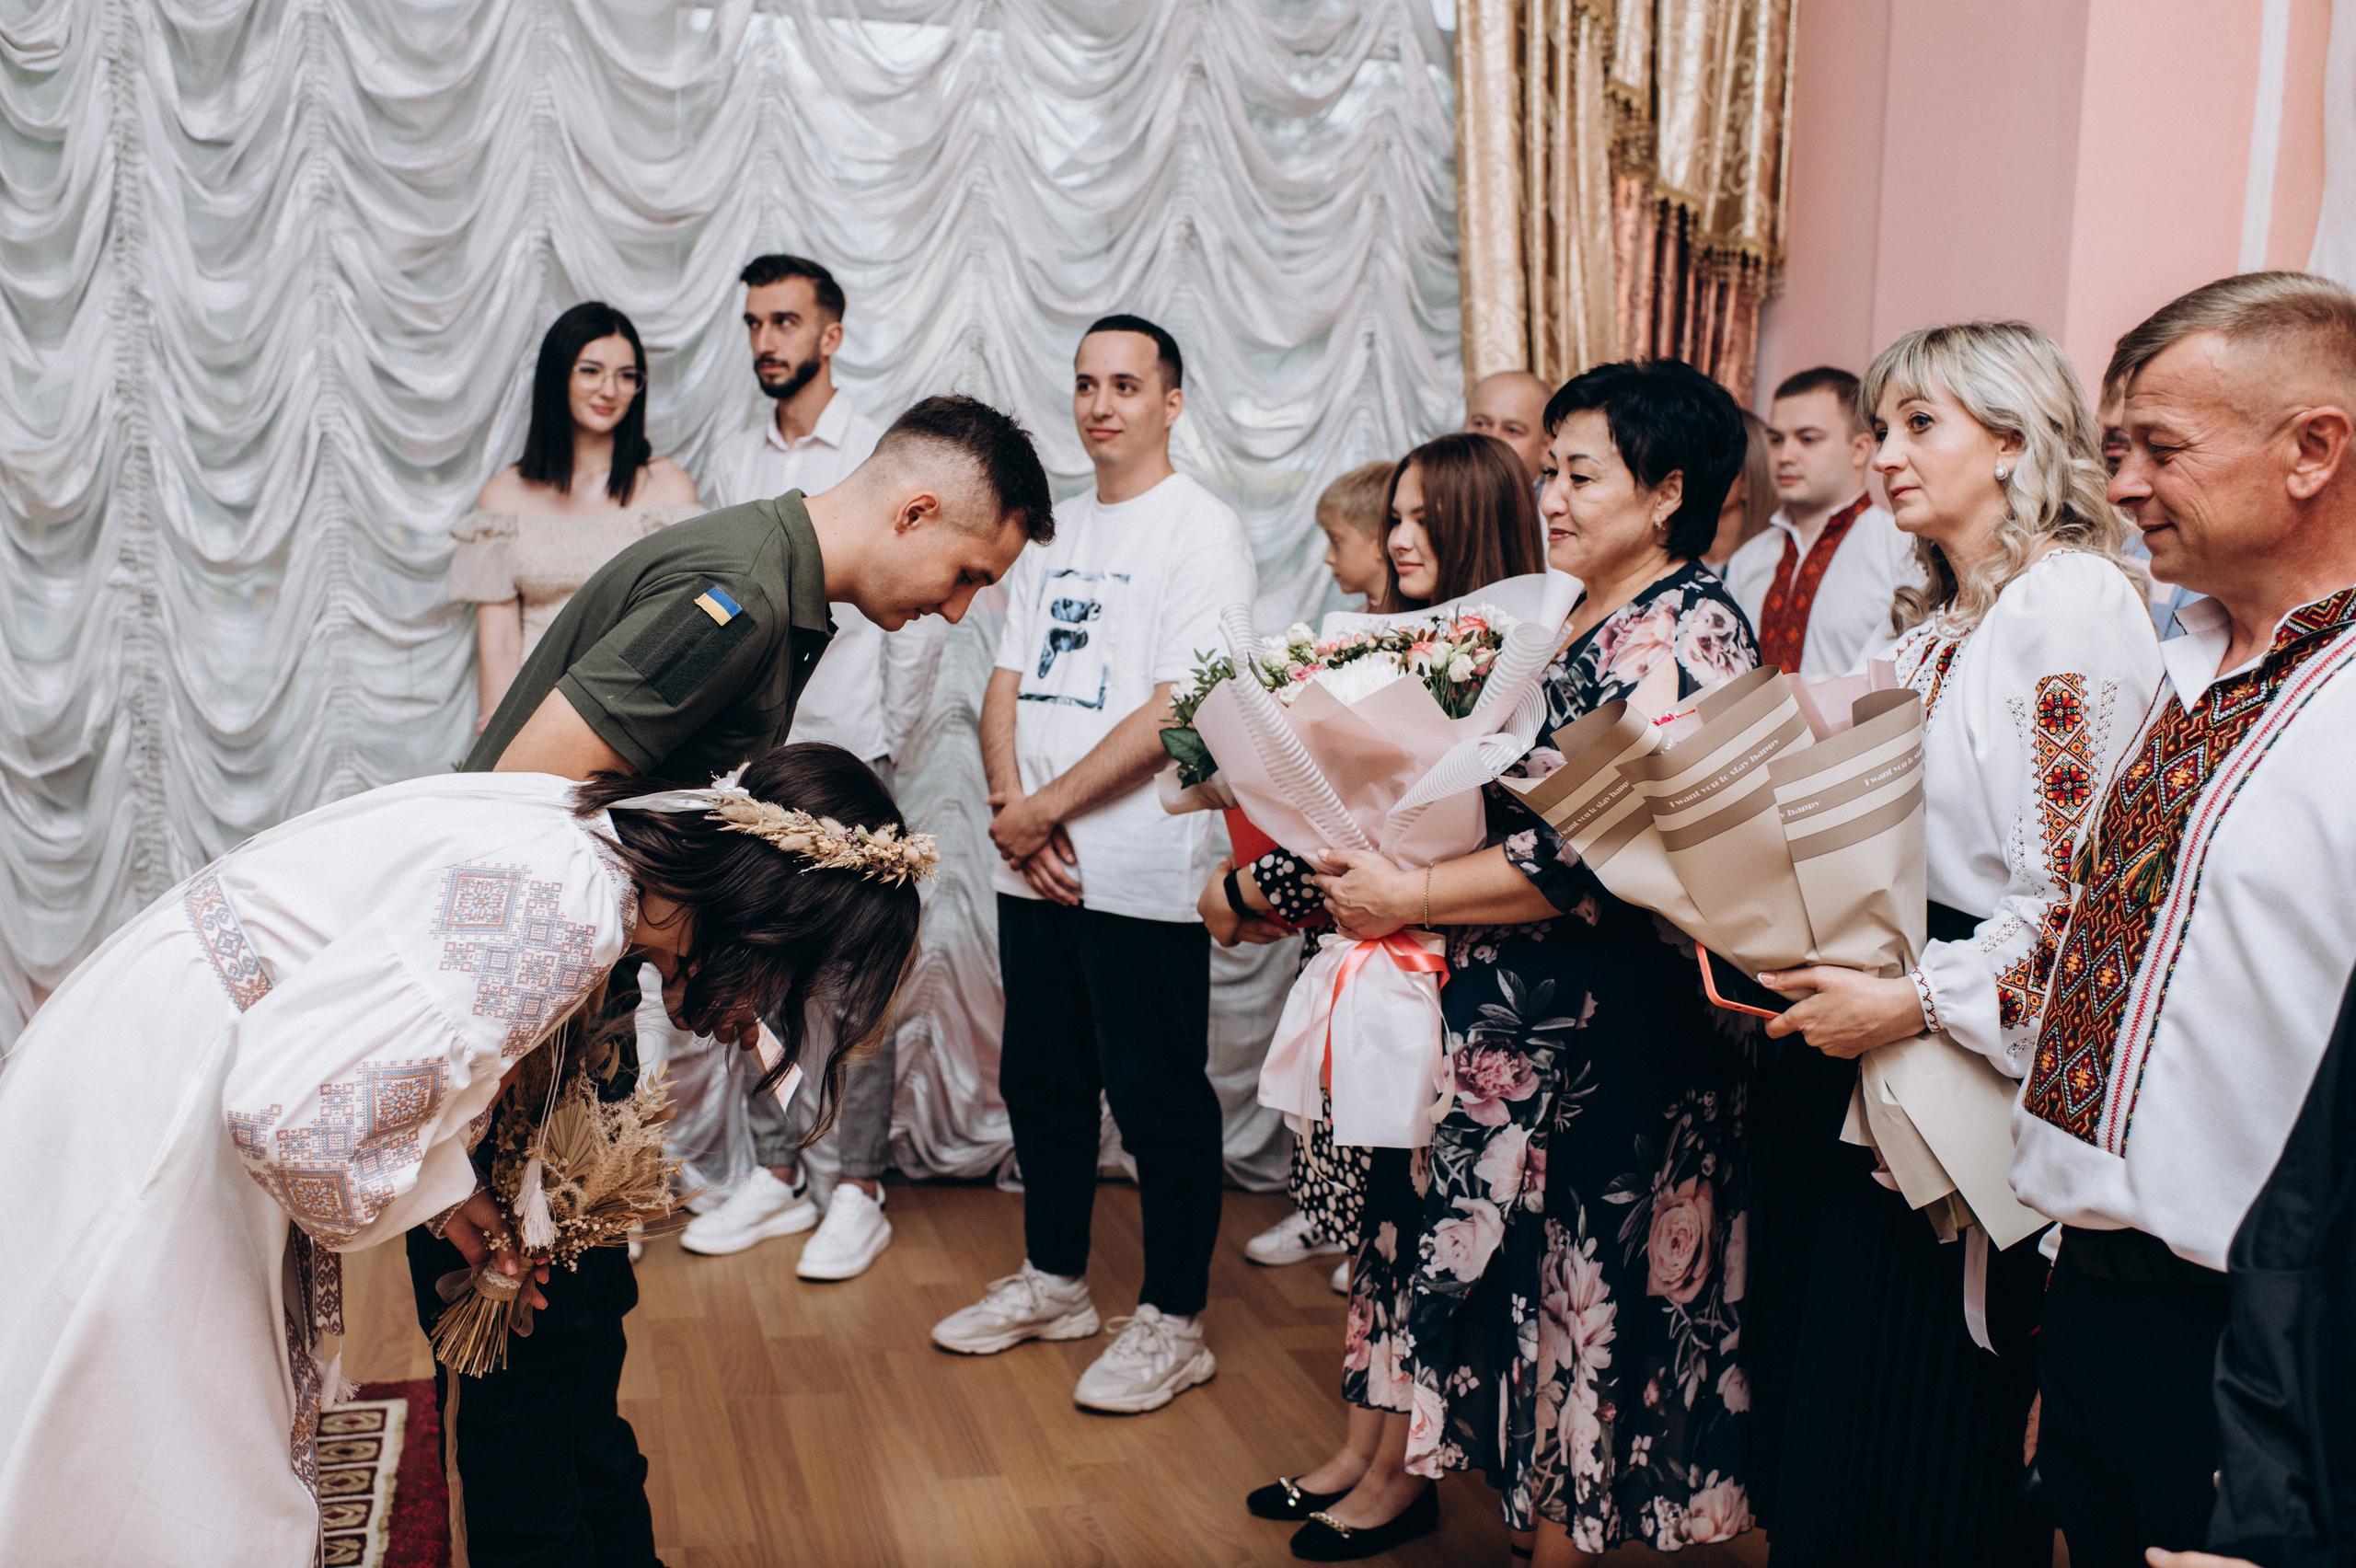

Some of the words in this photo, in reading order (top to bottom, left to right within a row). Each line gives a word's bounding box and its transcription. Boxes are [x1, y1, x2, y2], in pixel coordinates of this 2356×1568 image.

[1675, 790, 1701, 805] want
[1701, 780, 1719, 793] you
[1718, 773, 1730, 783] to
[1730, 759, 1750, 776] stay
[1749, 738, 1779, 763] happy
[1864, 778, 1869, 787] I
[1869, 767, 1892, 783] want
[1892, 760, 1908, 773] you
[1907, 757, 1914, 766] to
[1562, 821, 1579, 835] want
[1576, 813, 1591, 823] you
[1596, 796, 1611, 809] stay
[1609, 779, 1630, 798] happ
[1786, 800, 1820, 817] happy
